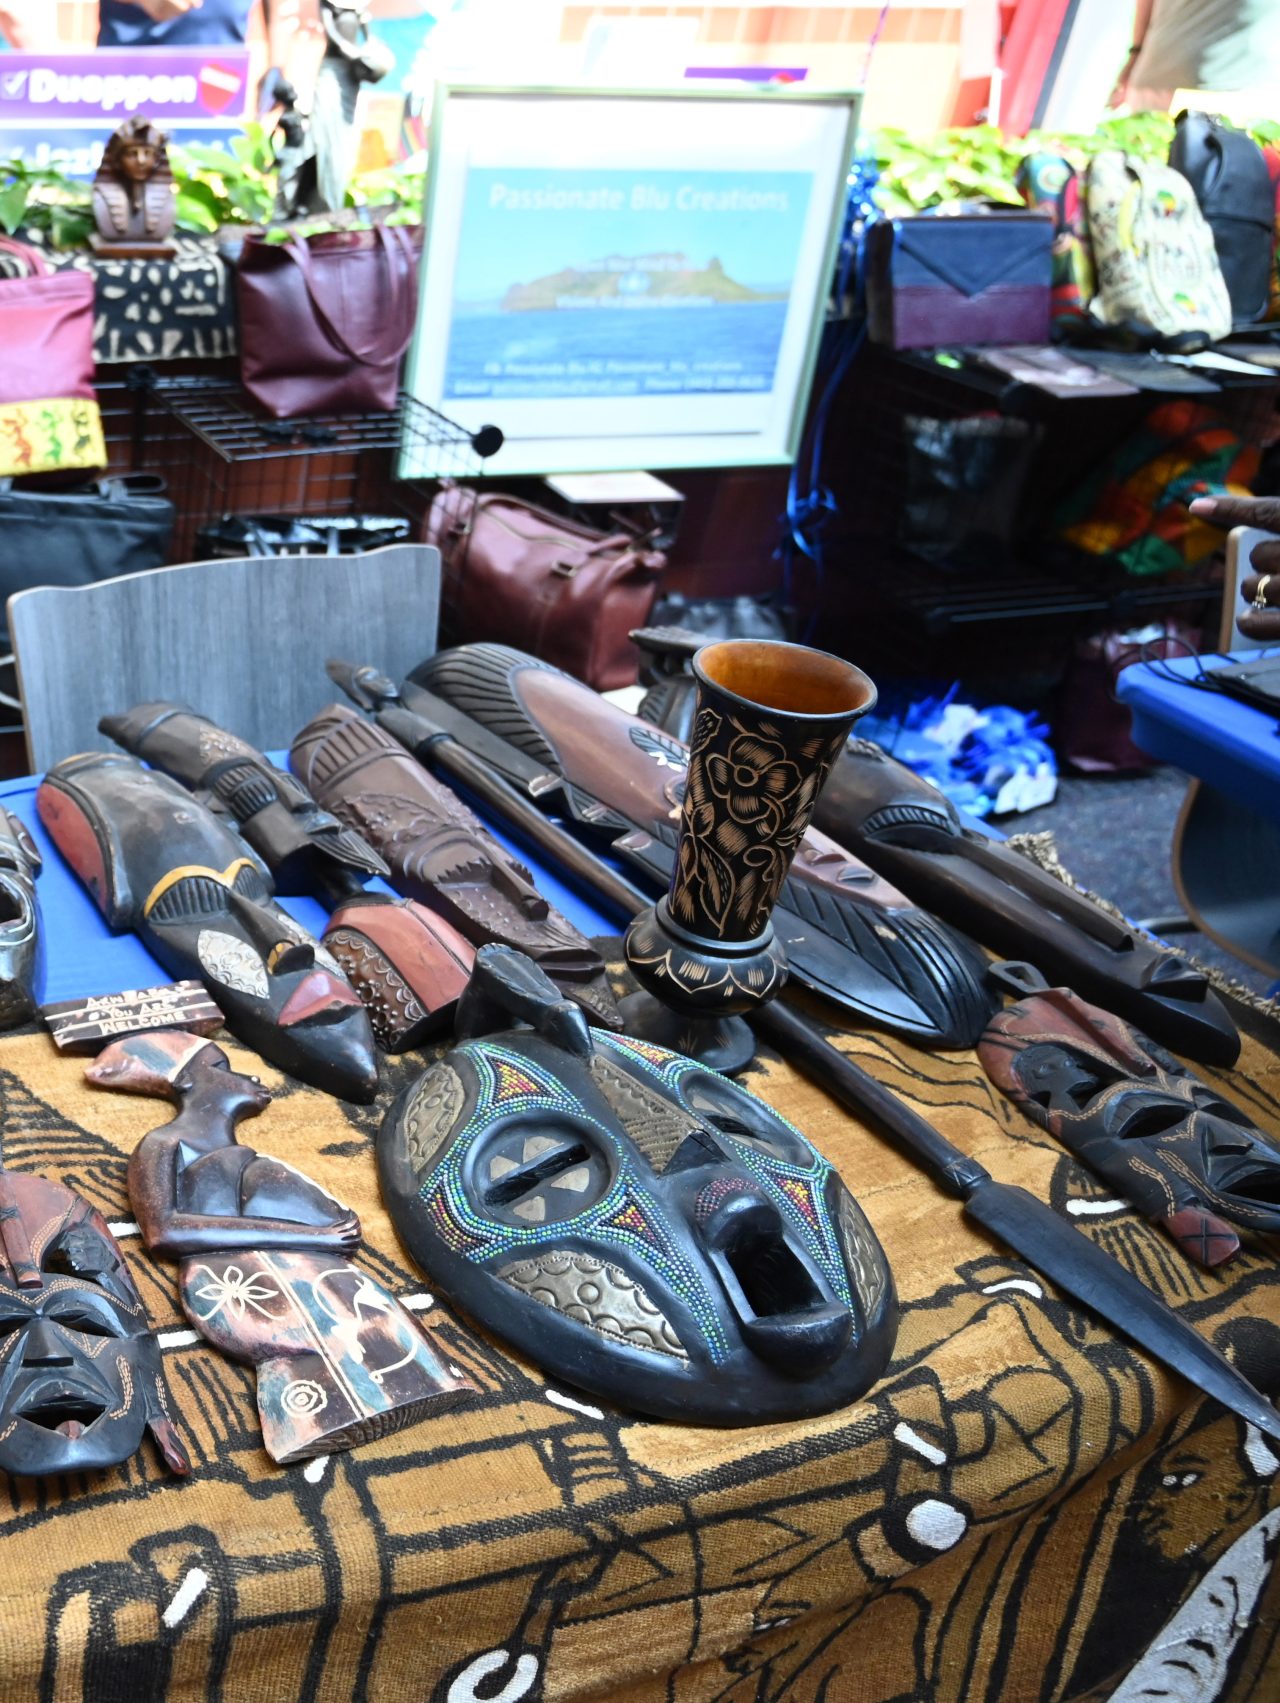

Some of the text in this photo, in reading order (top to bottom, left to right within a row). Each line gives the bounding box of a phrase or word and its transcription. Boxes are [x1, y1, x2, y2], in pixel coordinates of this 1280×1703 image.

[489, 183, 789, 212] Passionate Blu Creations
[99, 1011, 186, 1035] WELCOME
